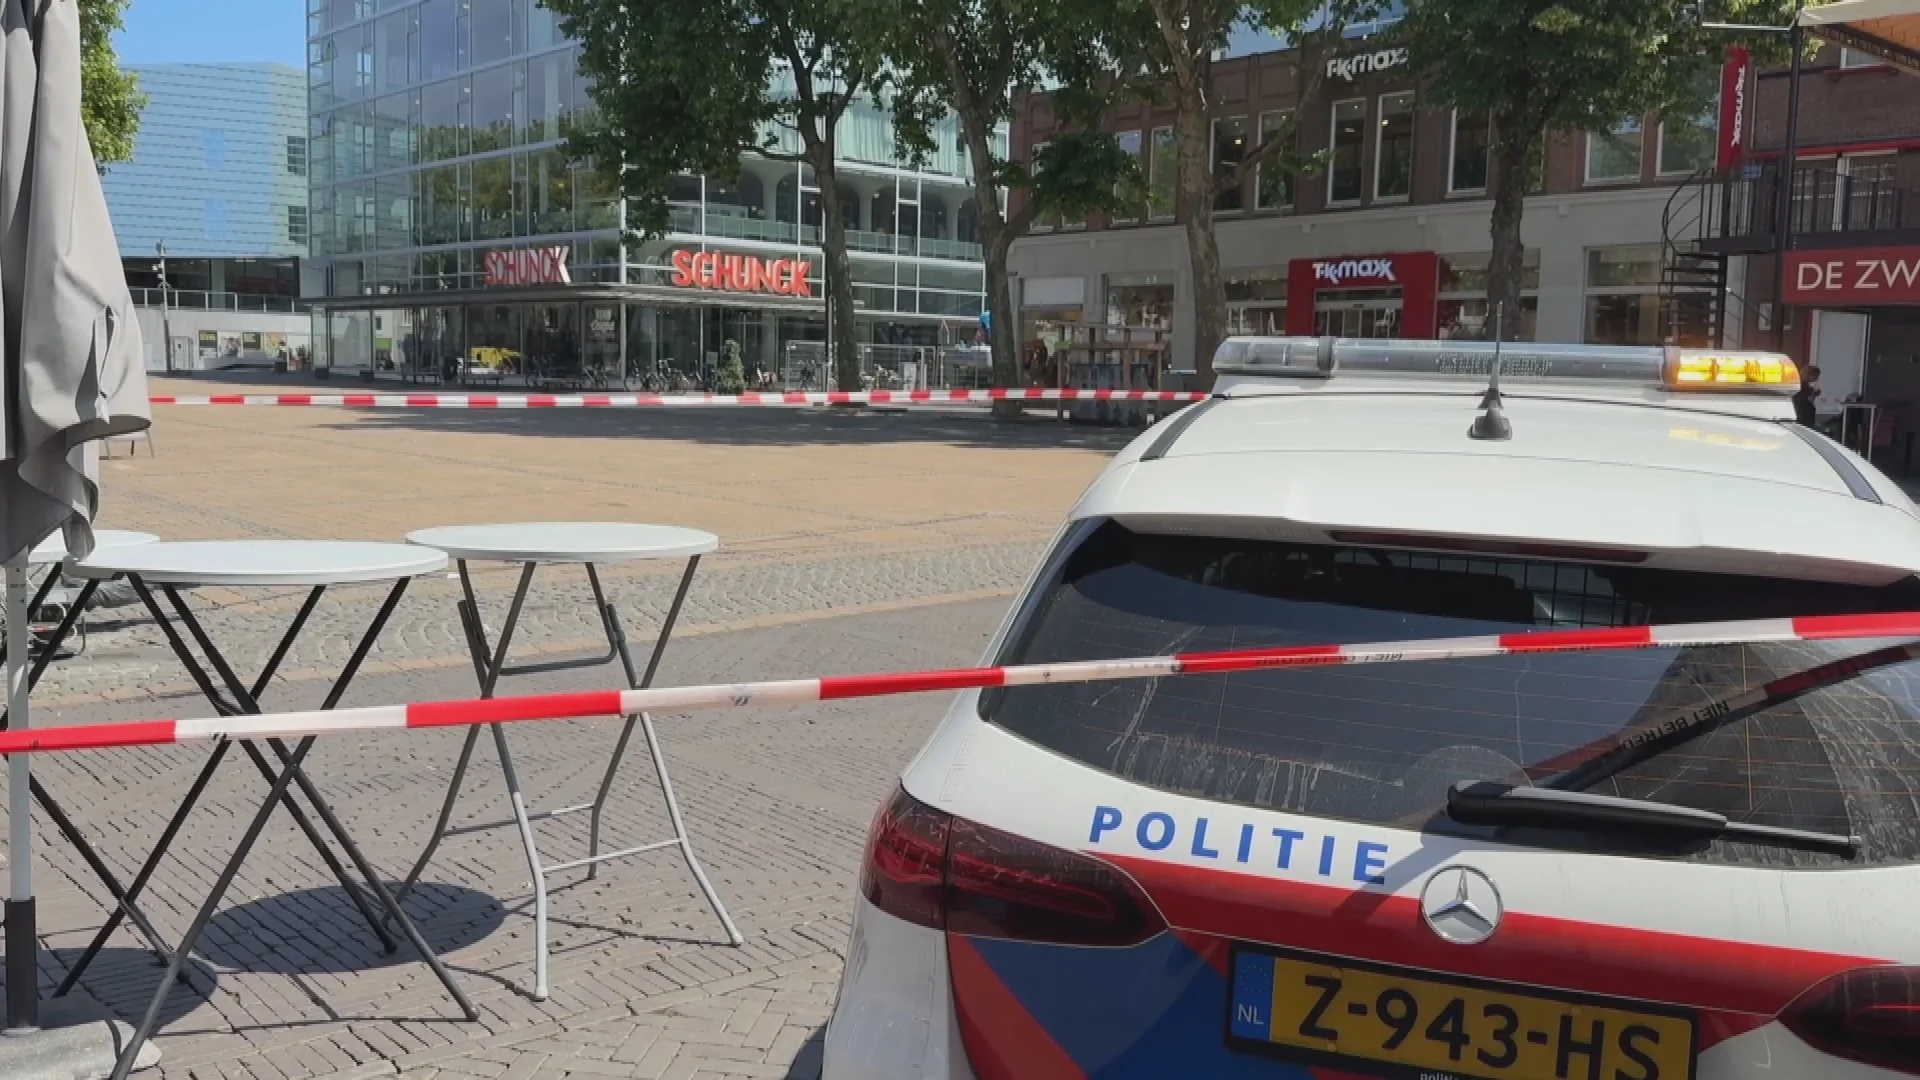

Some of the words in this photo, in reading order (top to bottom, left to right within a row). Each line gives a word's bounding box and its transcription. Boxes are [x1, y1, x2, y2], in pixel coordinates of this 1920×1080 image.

[483, 245, 571, 286] SCHUNCK
[672, 249, 810, 296] SCHUNCK
[1797, 261, 1844, 290] DE
[1853, 259, 1920, 289] ZW
[1089, 805, 1388, 885] POLITIE
[1236, 1003, 1264, 1026] NL
[1298, 974, 1660, 1080] Z-943-HS
